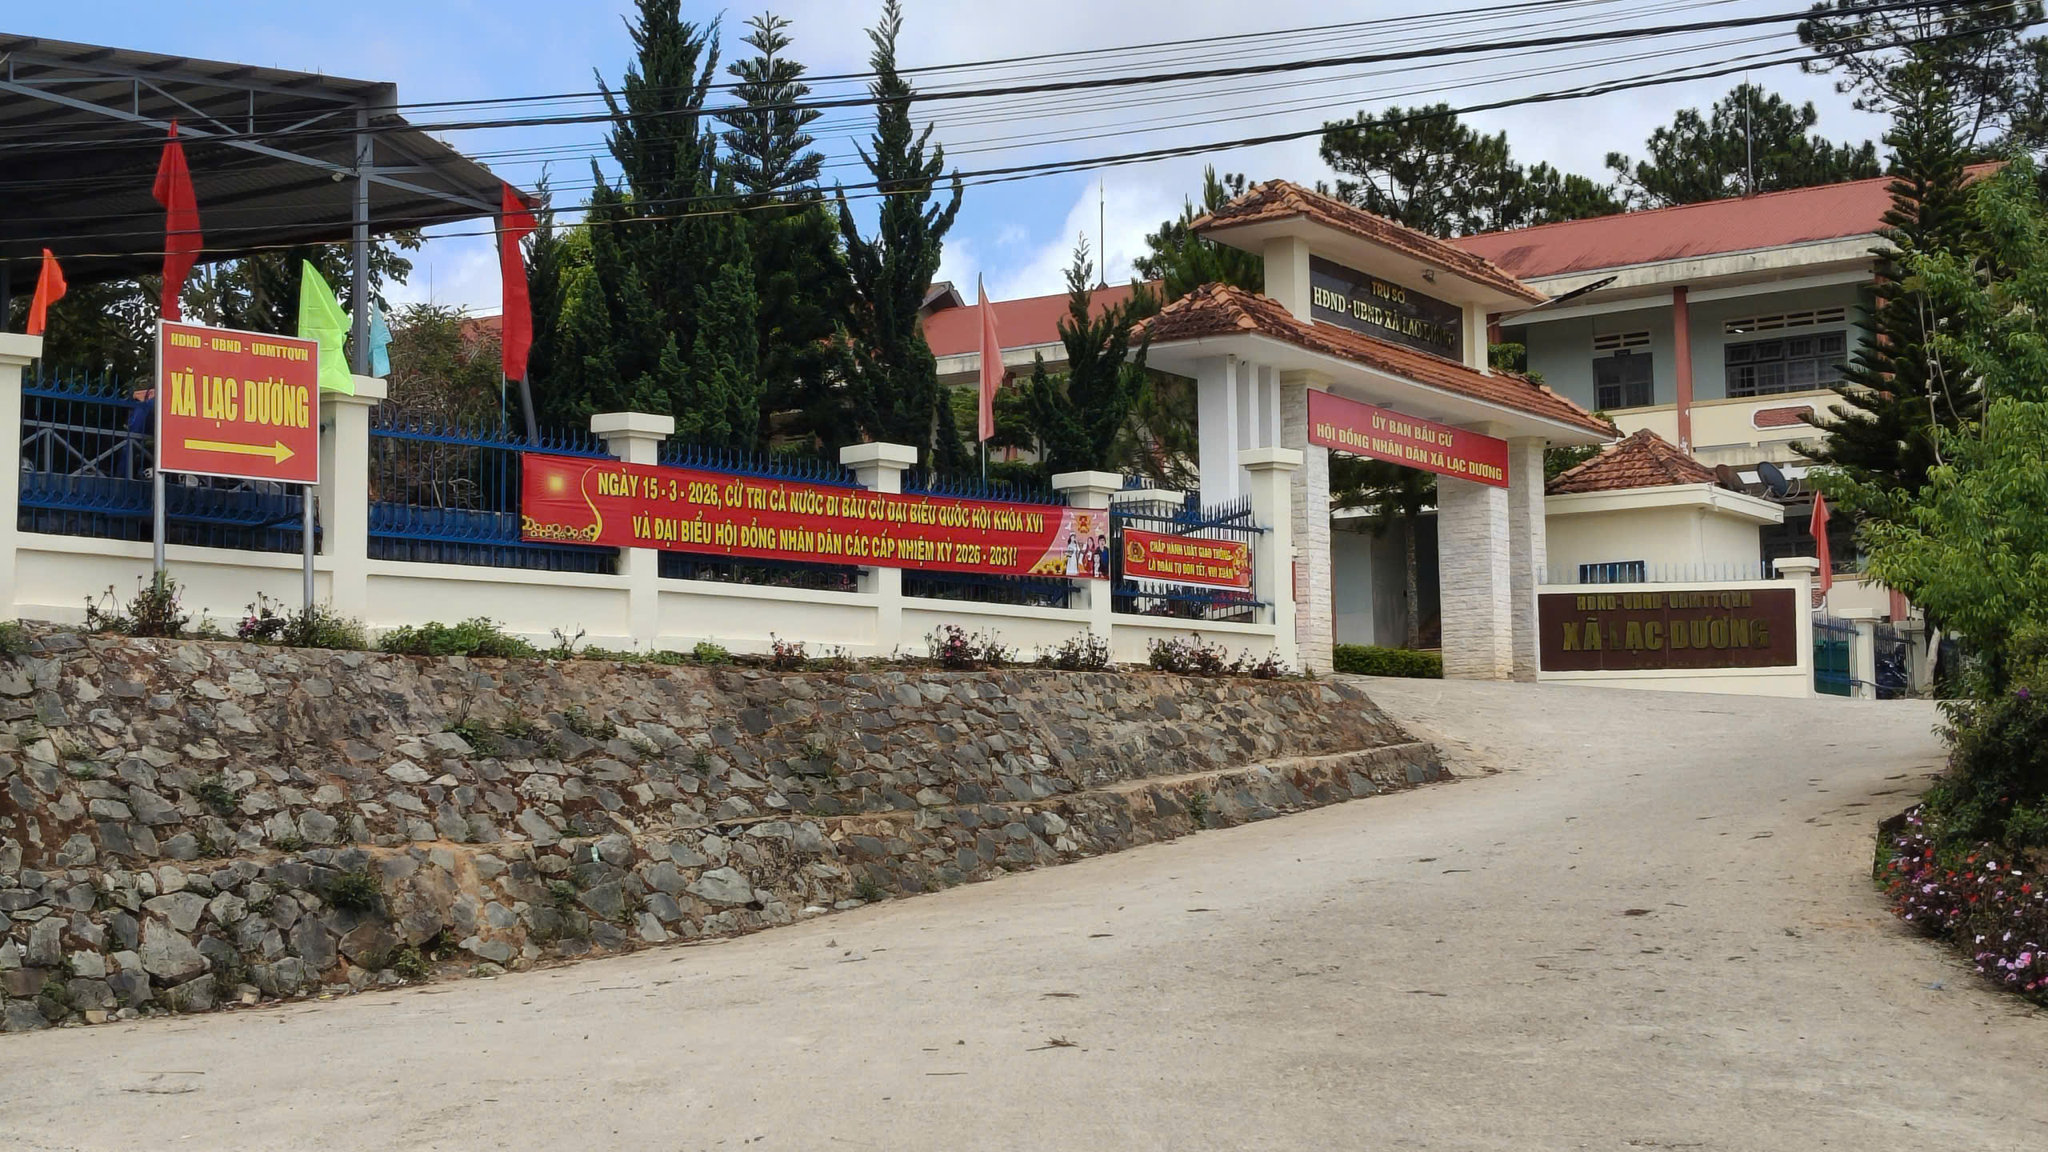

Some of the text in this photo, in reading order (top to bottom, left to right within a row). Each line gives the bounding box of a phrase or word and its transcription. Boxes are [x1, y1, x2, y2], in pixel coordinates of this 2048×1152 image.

[1313, 286, 1346, 313] HĐND
[1352, 300, 1383, 325] UBND
[1371, 281, 1390, 302] TRỤ
[212, 338, 241, 353] UBND
[252, 342, 309, 361] UBMTTQVN
[170, 367, 310, 429] XÃ LẠC DƯƠNG
[1372, 411, 1386, 431] ỦY
[1389, 420, 1412, 438] BAN
[1316, 422, 1336, 442] HỘI
[1372, 437, 1403, 458] NHÂN
[1405, 445, 1428, 464] DÂN
[1430, 451, 1445, 468] XÃ
[1446, 456, 1466, 473] LẠC
[1468, 461, 1503, 481] DƯƠNG
[598, 467, 639, 498] NGÀY
[643, 476, 658, 500] 15
[669, 479, 677, 502] 3
[688, 481, 721, 510] 2026,
[725, 478, 744, 508] CỬ
[746, 487, 767, 510] TRI
[769, 483, 787, 512] CẢ
[790, 488, 824, 515] NƯỚC
[826, 495, 839, 517] ĐI
[868, 493, 886, 520] CỬ
[887, 501, 907, 528] ĐẠI
[938, 500, 969, 527] QUỐC
[972, 505, 991, 535] HỘI
[1026, 512, 1044, 533] XVI
[632, 510, 651, 539] VÀ
[654, 517, 678, 548] ĐẠI
[681, 509, 712, 545] BIỂU
[715, 518, 738, 553] HỘI
[780, 525, 814, 553] NHÂN
[817, 527, 842, 555] DÂN
[845, 529, 869, 557] CÁC
[871, 528, 896, 559] CẤP
[898, 535, 935, 567] NHIỆM
[955, 543, 981, 565] 2026
[989, 545, 1018, 567] 2031!
[1562, 617, 1602, 651] XÃ
[1670, 615, 1771, 650] DƯƠNG
